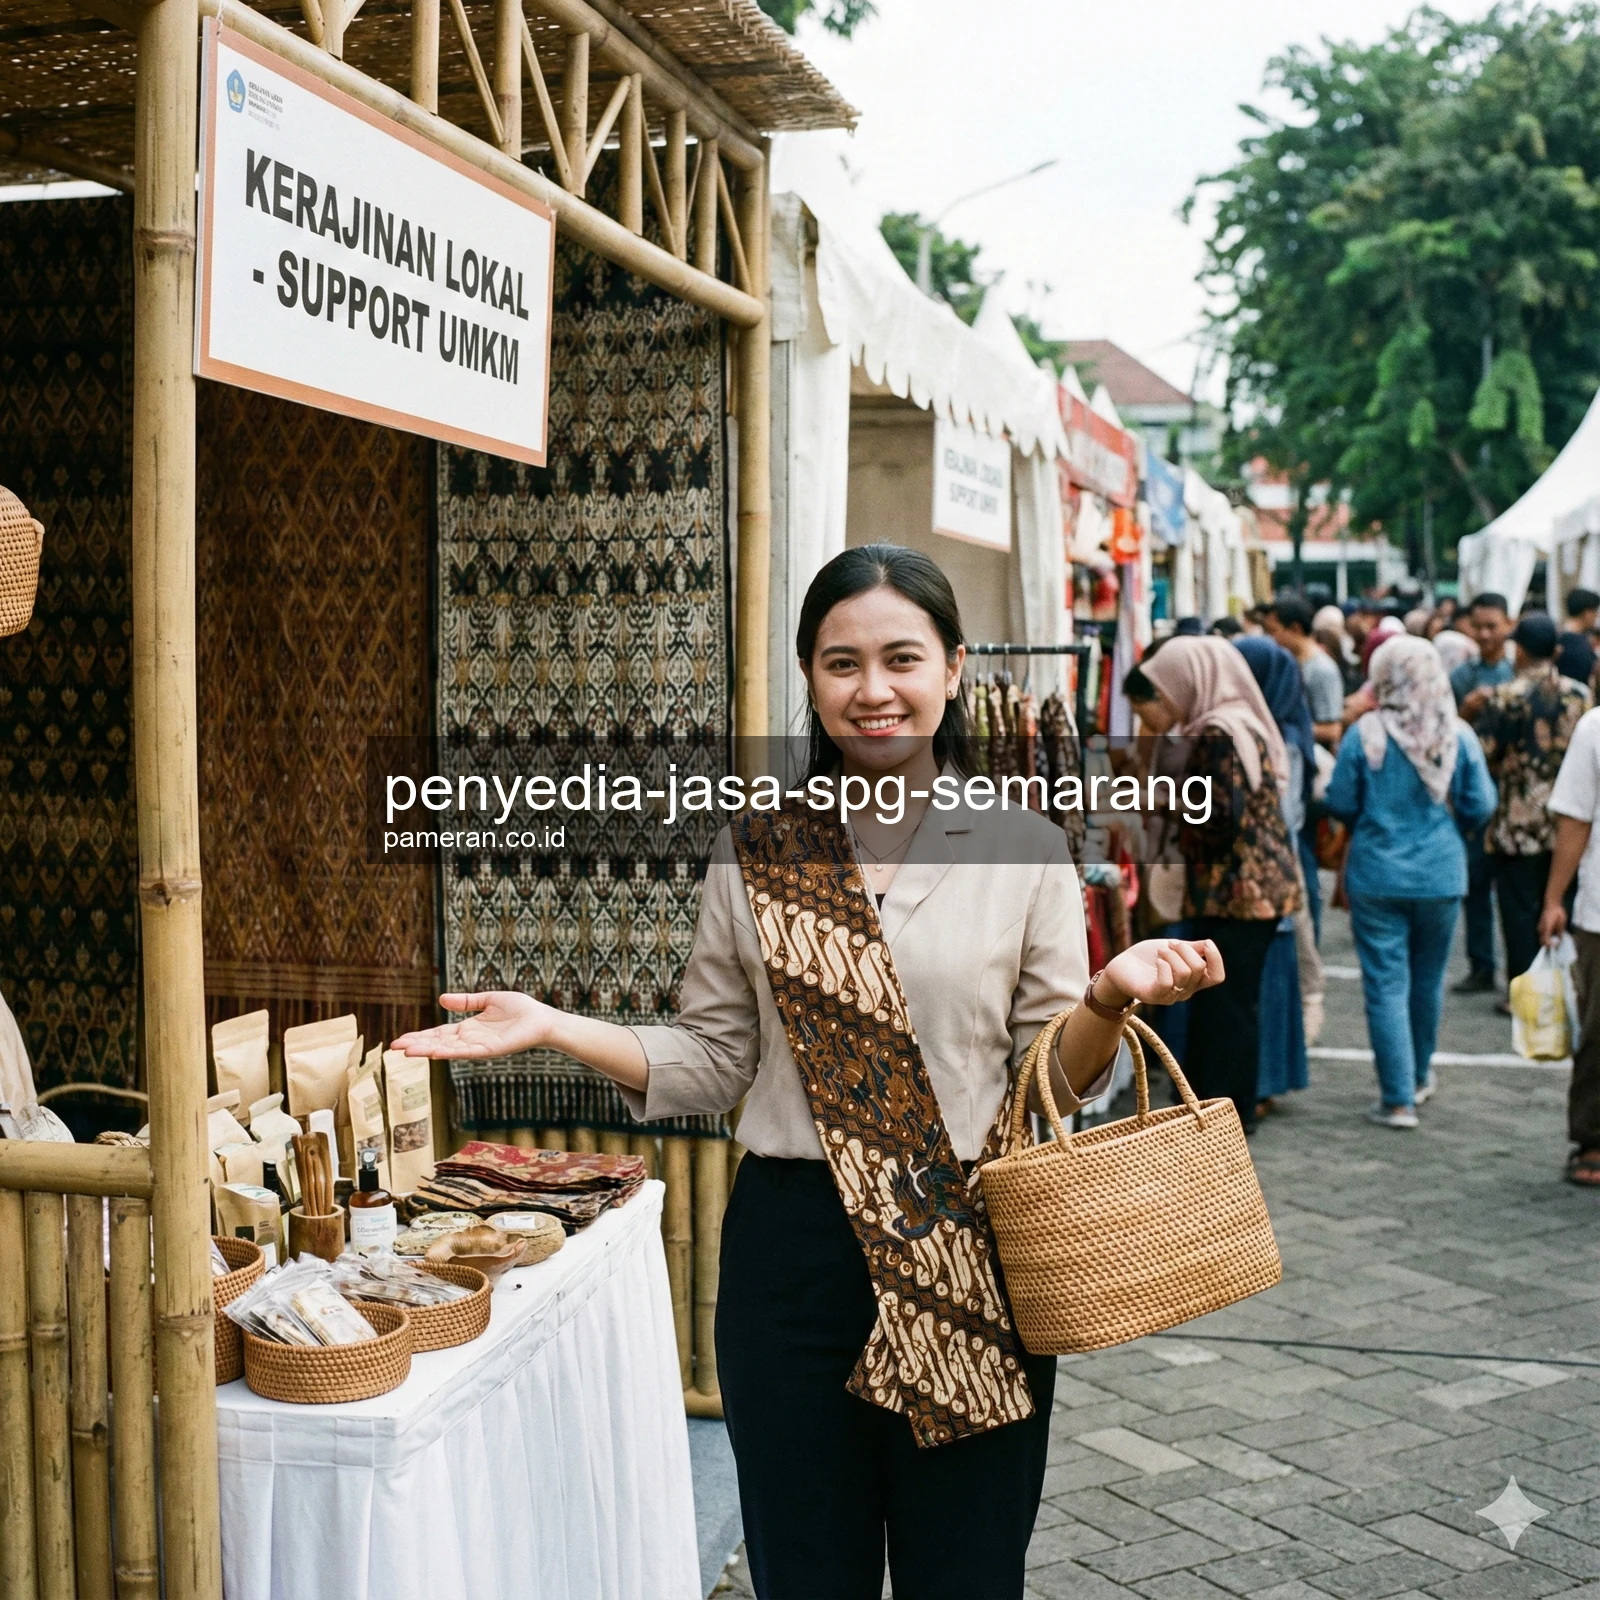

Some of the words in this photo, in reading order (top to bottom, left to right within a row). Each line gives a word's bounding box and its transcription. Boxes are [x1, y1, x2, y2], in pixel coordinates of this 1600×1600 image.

[245, 148, 436, 282] KERAJINAN
[445, 239, 530, 321] LOKAL
[276, 250, 431, 353] SUPPORT
[438, 310, 520, 385] UMKM
